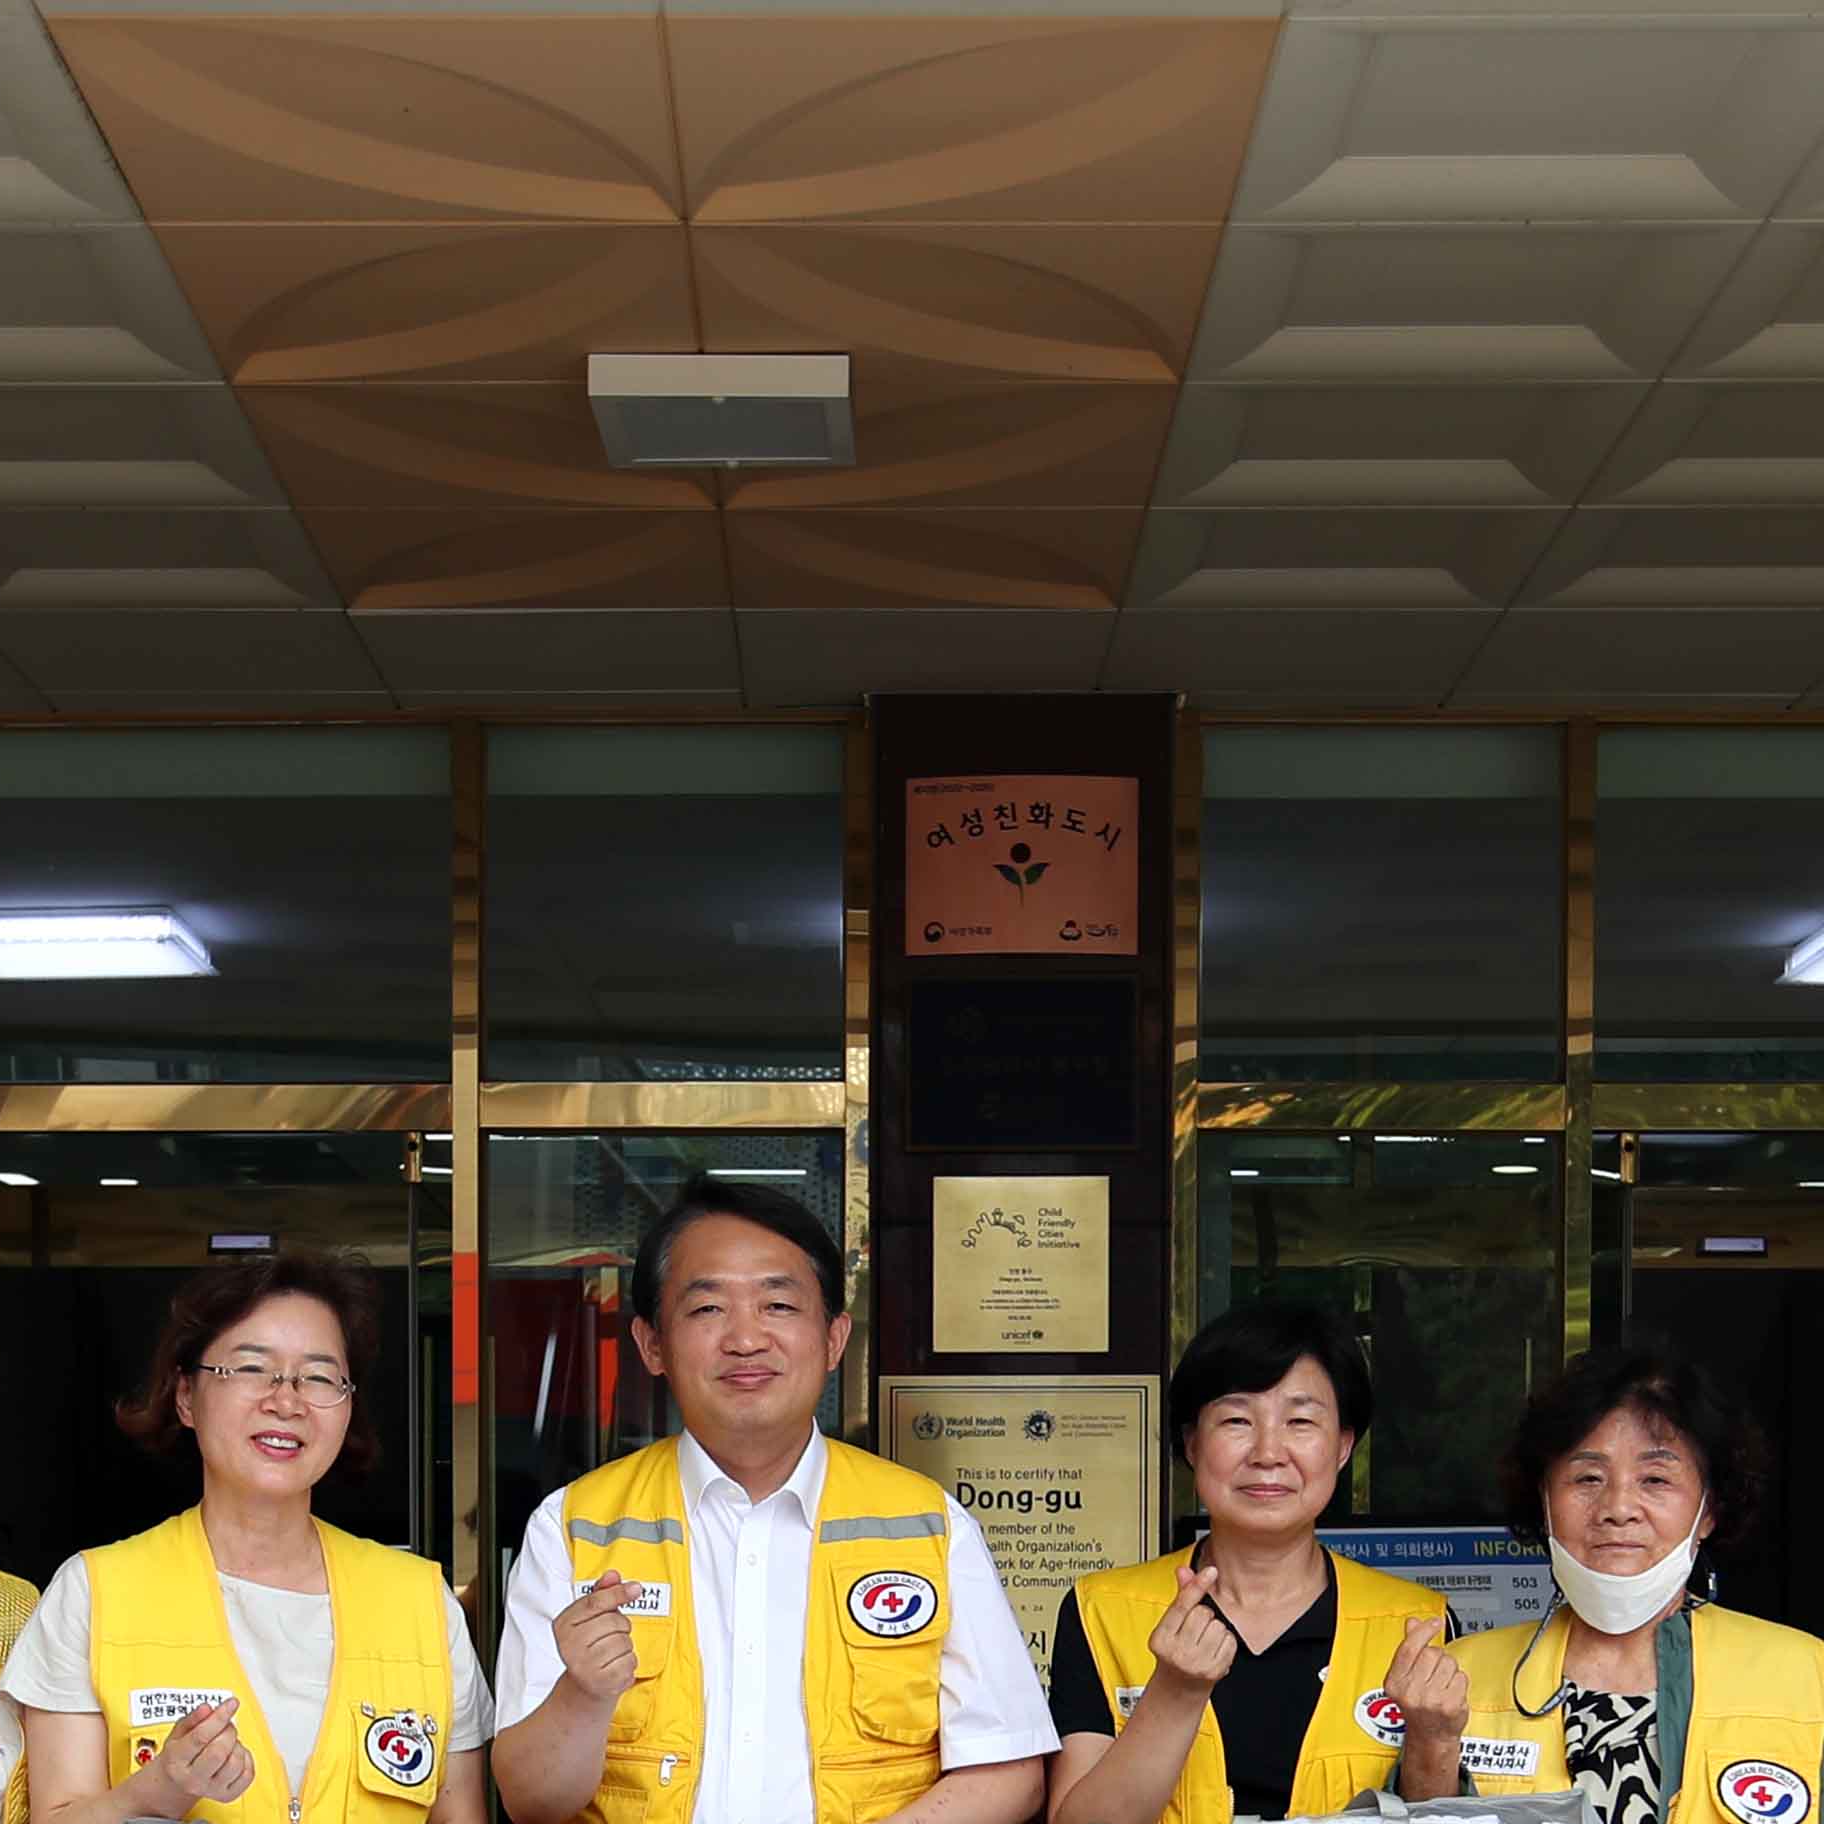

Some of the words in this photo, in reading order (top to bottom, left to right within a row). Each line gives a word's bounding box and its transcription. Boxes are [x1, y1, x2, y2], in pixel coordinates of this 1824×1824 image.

[927, 801, 1121, 850] 여성친화도시
[1039, 1208, 1062, 1216] Child
[1038, 1219, 1075, 1228] Friendly
[1001, 1330, 1031, 1339] unicef
[946, 1417, 972, 1427] World
[976, 1417, 1006, 1428] Health
[946, 1428, 1006, 1439] Organization
[957, 1468, 982, 1480] This
[986, 1468, 996, 1480] is
[1000, 1468, 1011, 1480] to
[1015, 1468, 1054, 1481] certify
[1058, 1468, 1082, 1480] that
[956, 1483, 1082, 1512] Dong-gu
[988, 1524, 1036, 1535] member
[1041, 1524, 1052, 1535] of
[1057, 1524, 1075, 1535] the
[1016, 1539, 1102, 1554] Organization's
[1020, 1558, 1036, 1570] for
[1512, 1577, 1538, 1589] 503
[1515, 1598, 1540, 1610] 505
[1461, 1756, 1526, 1768] 천광역시지사
